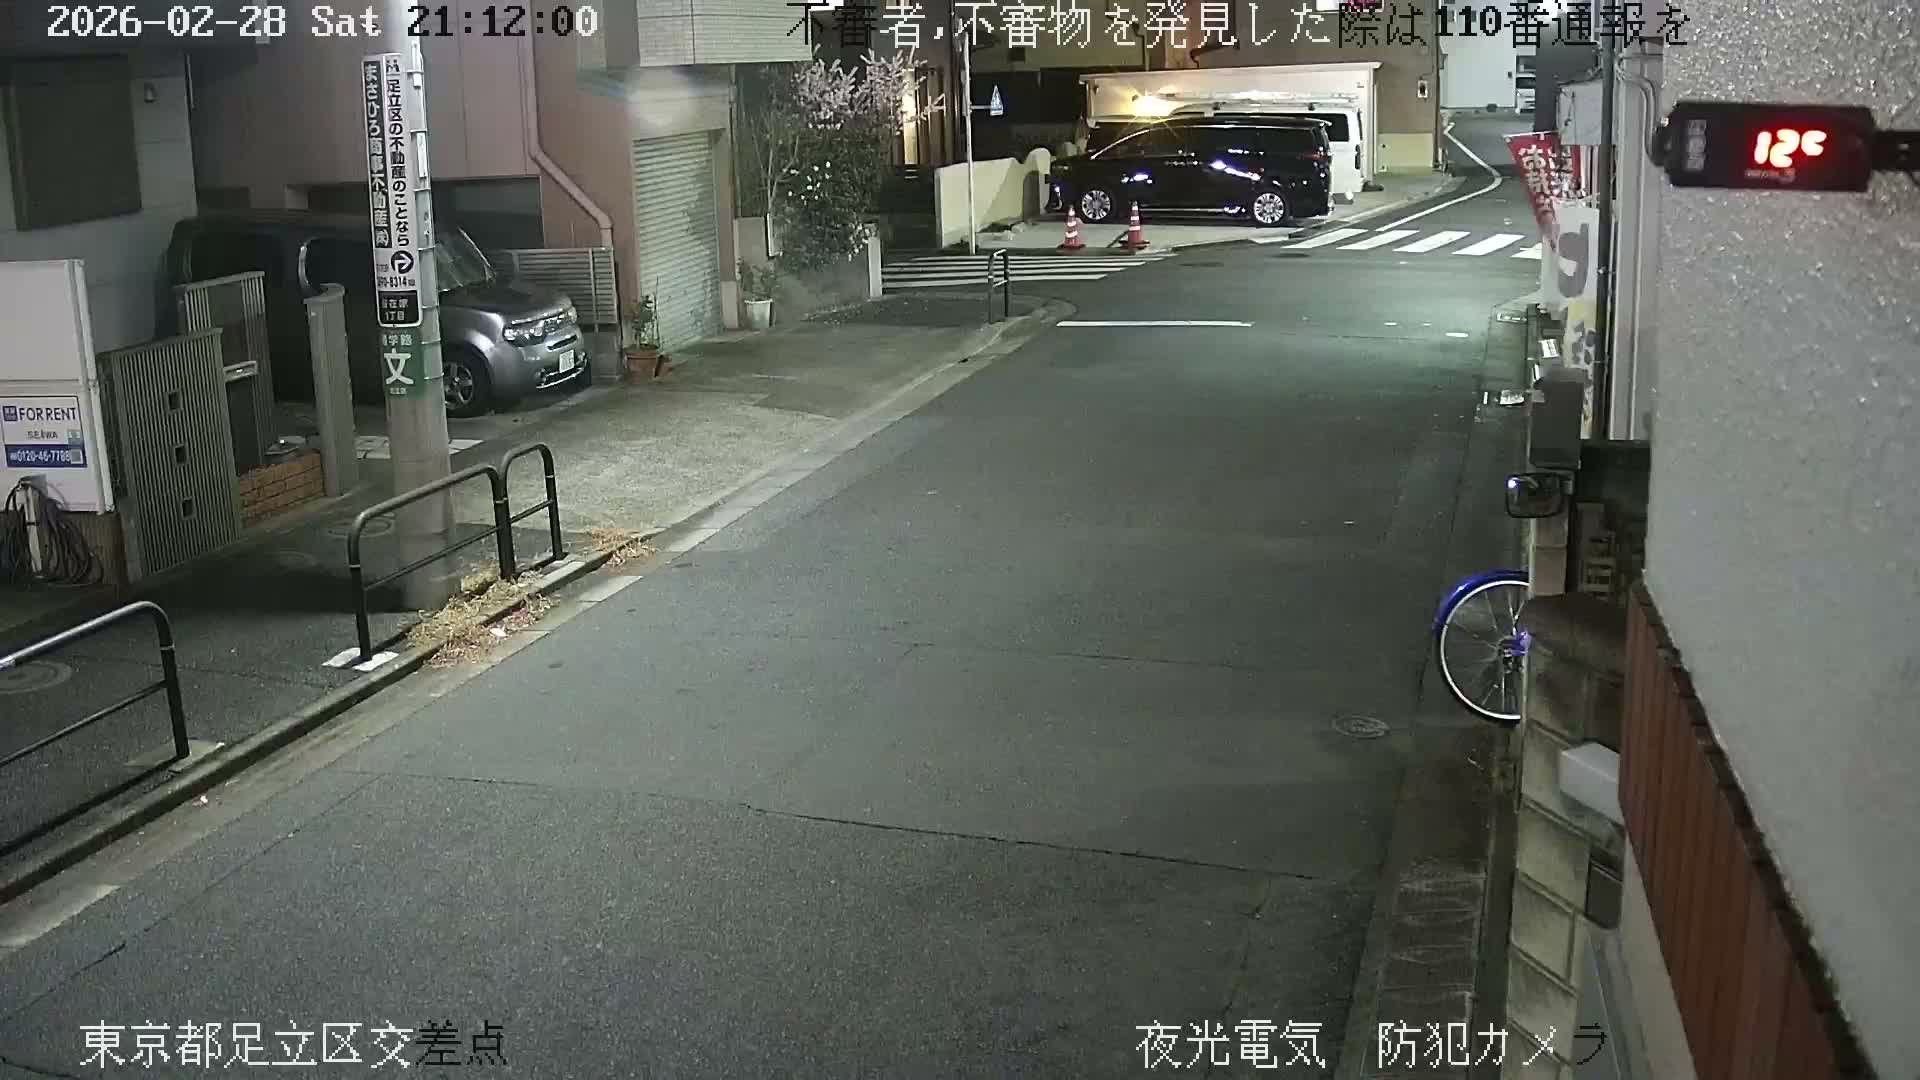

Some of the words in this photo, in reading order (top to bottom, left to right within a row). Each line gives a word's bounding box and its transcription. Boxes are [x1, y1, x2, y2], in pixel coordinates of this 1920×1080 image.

[387, 79, 410, 247] 足立区の不動産のことなら
[19, 407, 44, 421] FOR
[46, 407, 76, 421] RENT
